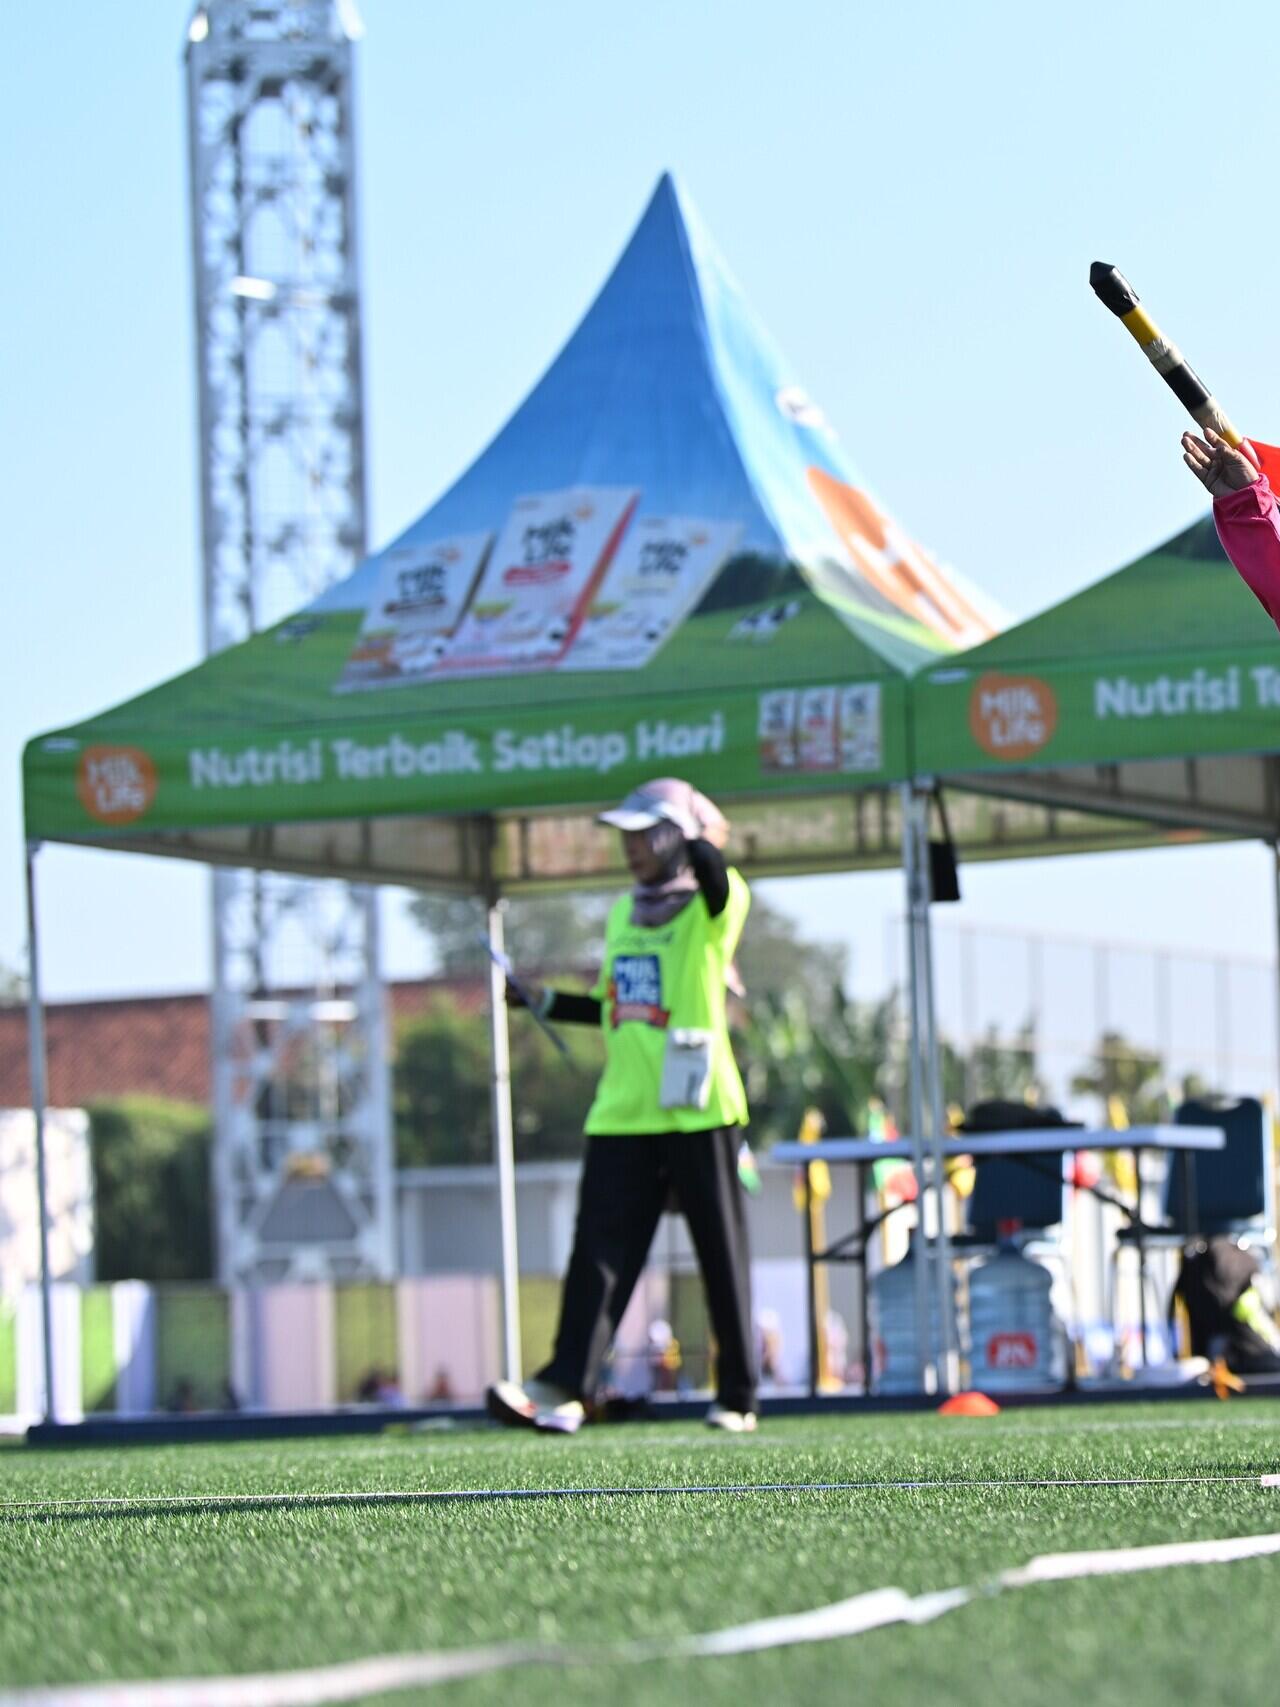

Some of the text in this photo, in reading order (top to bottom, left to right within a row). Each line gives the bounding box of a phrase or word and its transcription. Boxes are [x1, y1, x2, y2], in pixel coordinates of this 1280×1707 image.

[981, 685, 1040, 719] Milk
[1094, 665, 1241, 718] Nutrisi
[189, 740, 321, 788] Nutrisi
[332, 730, 481, 779] Terbaik
[492, 723, 628, 773] Setiap
[636, 711, 725, 758] Hari
[991, 717, 1045, 747] Life
